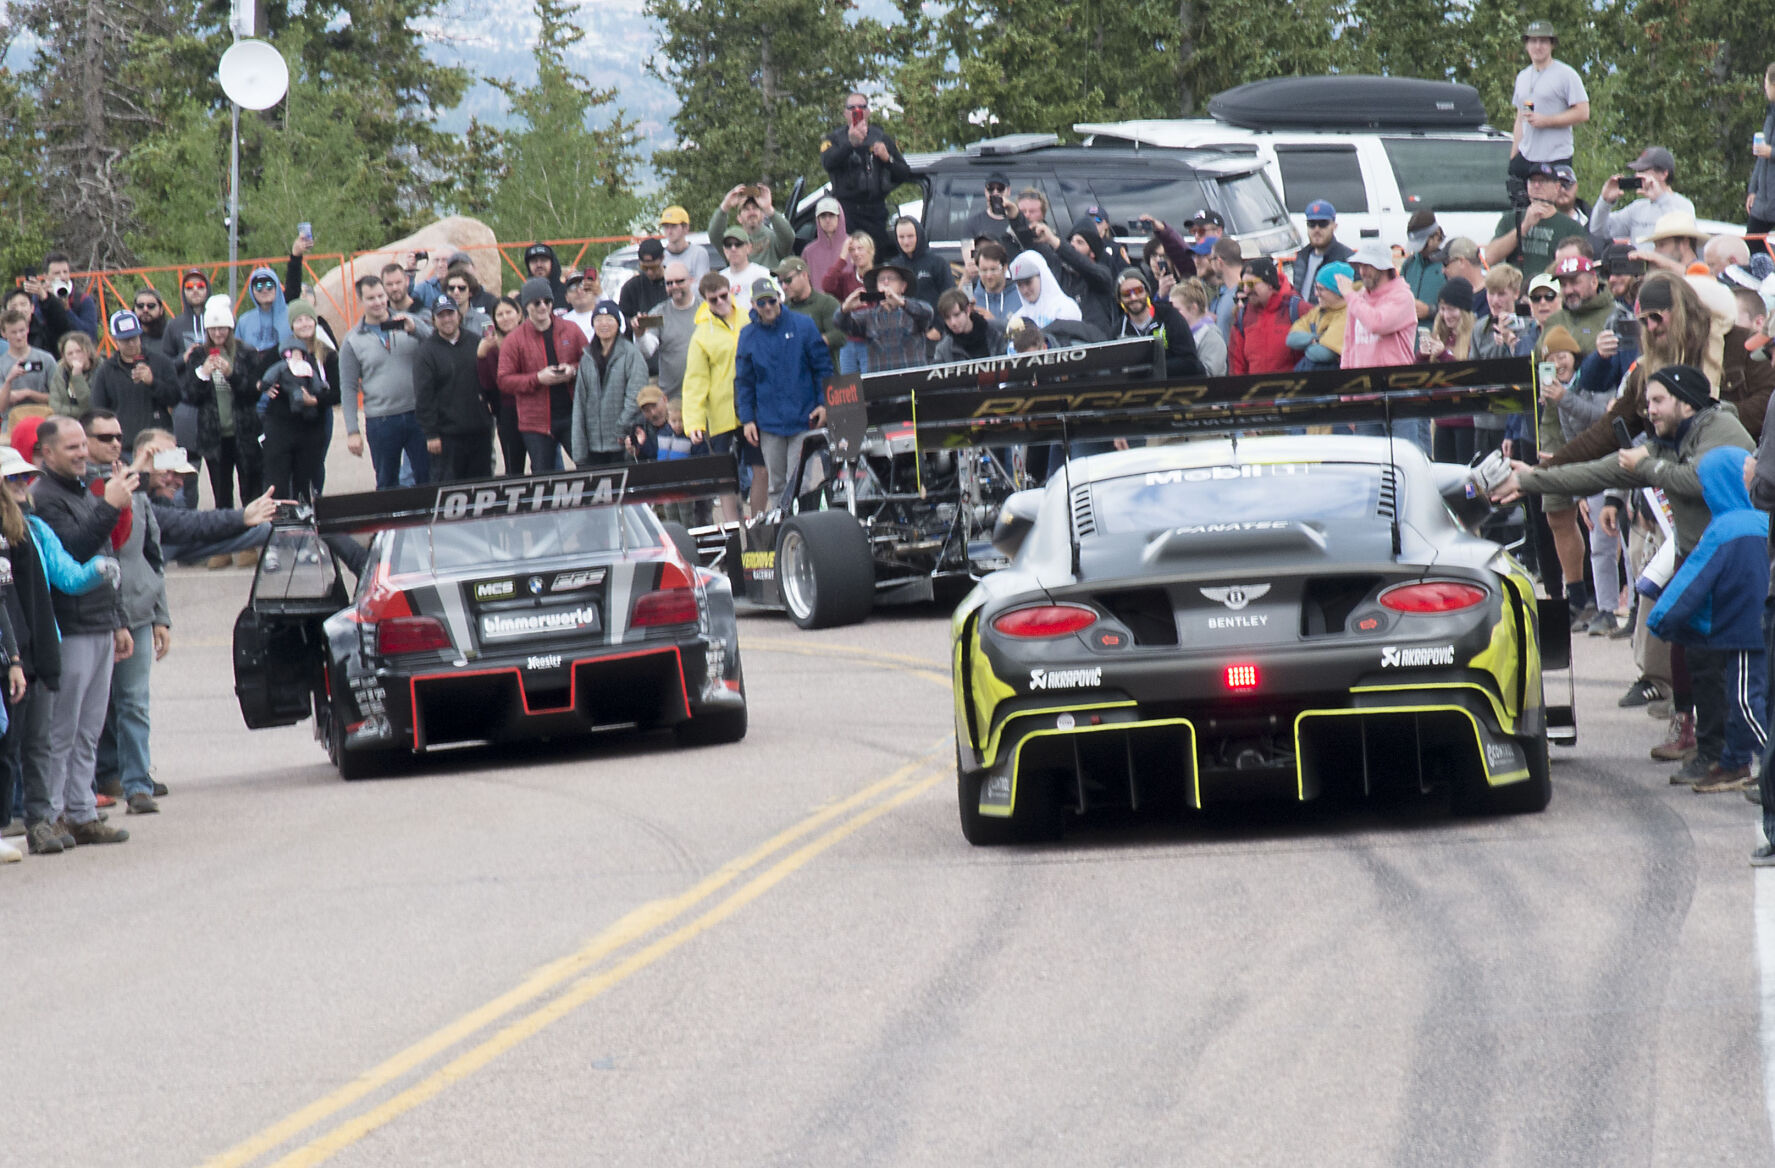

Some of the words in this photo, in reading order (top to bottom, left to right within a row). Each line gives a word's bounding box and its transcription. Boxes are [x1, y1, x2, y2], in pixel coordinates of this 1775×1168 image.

[927, 356, 1021, 381] AFFINITY
[1026, 350, 1087, 368] AERO
[826, 384, 859, 406] Garrett
[1146, 463, 1262, 486] Mobil
[443, 477, 614, 520] OPTIMA
[742, 551, 776, 569] VERDRIVE
[484, 607, 593, 633] bimmerworld
[1208, 614, 1268, 629] BENTLEY
